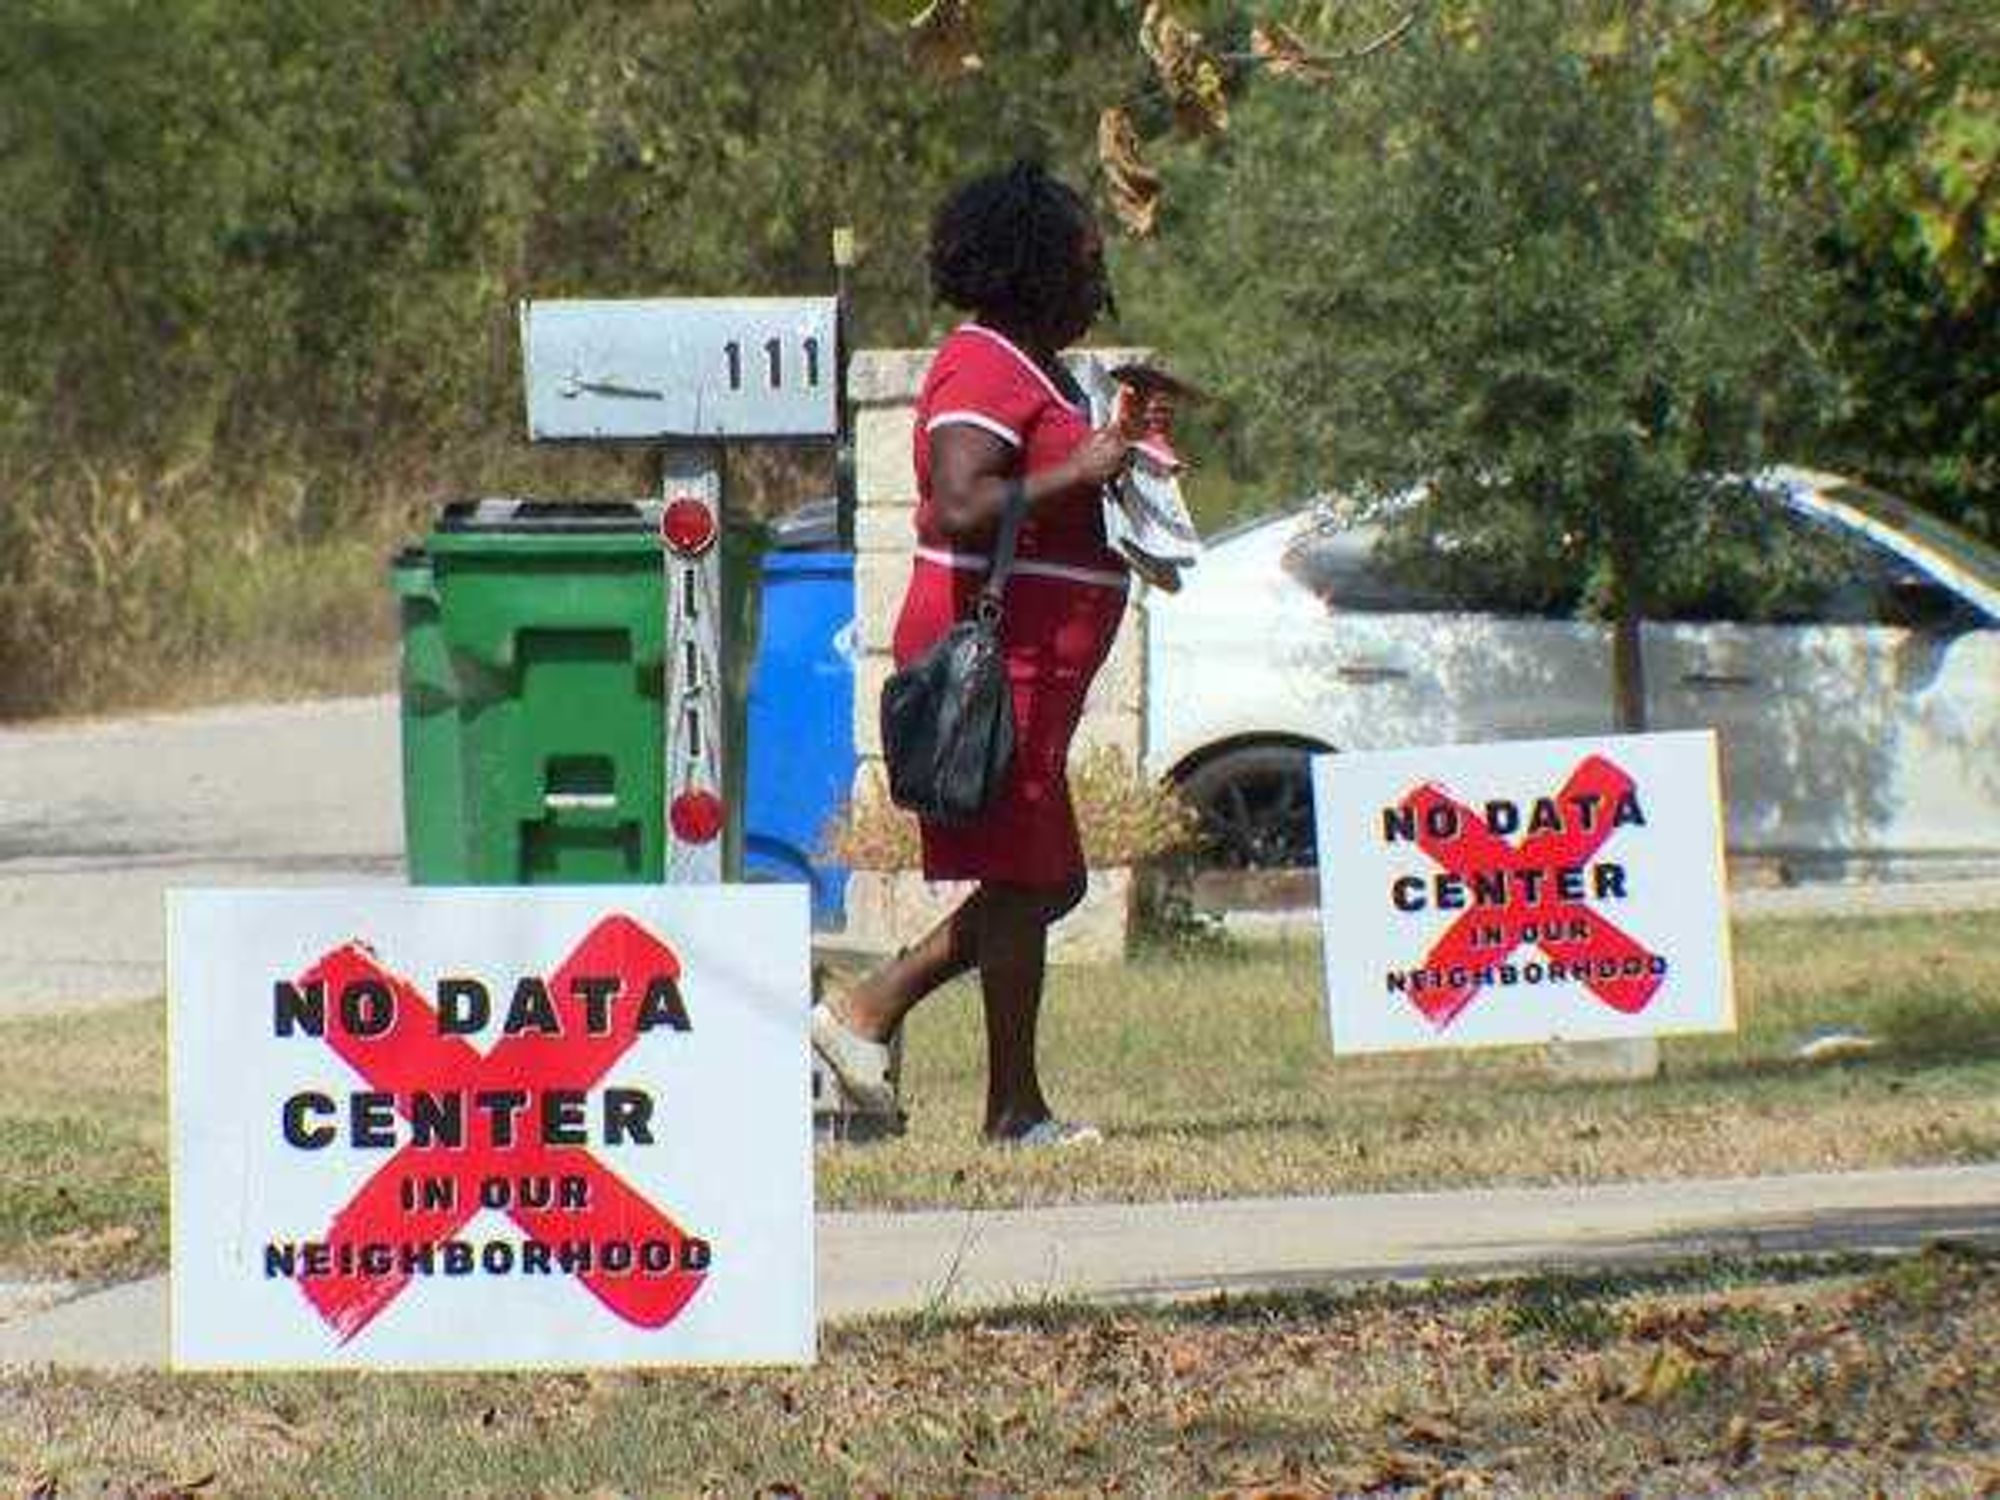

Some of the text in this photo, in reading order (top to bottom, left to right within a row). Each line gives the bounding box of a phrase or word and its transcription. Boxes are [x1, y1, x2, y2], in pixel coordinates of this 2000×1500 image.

[724, 337, 818, 390] 111
[1383, 789, 1646, 843] NO DATA
[1392, 862, 1627, 912] CENTER
[1470, 920, 1590, 946] IN OUR
[1387, 955, 1668, 994] NEIGHBORHOOD
[273, 976, 692, 1037] NO DATA
[282, 1089, 655, 1150] CENTER
[401, 1175, 590, 1211] IN OUR
[264, 1236, 712, 1279] NEIGHBORHOOD
